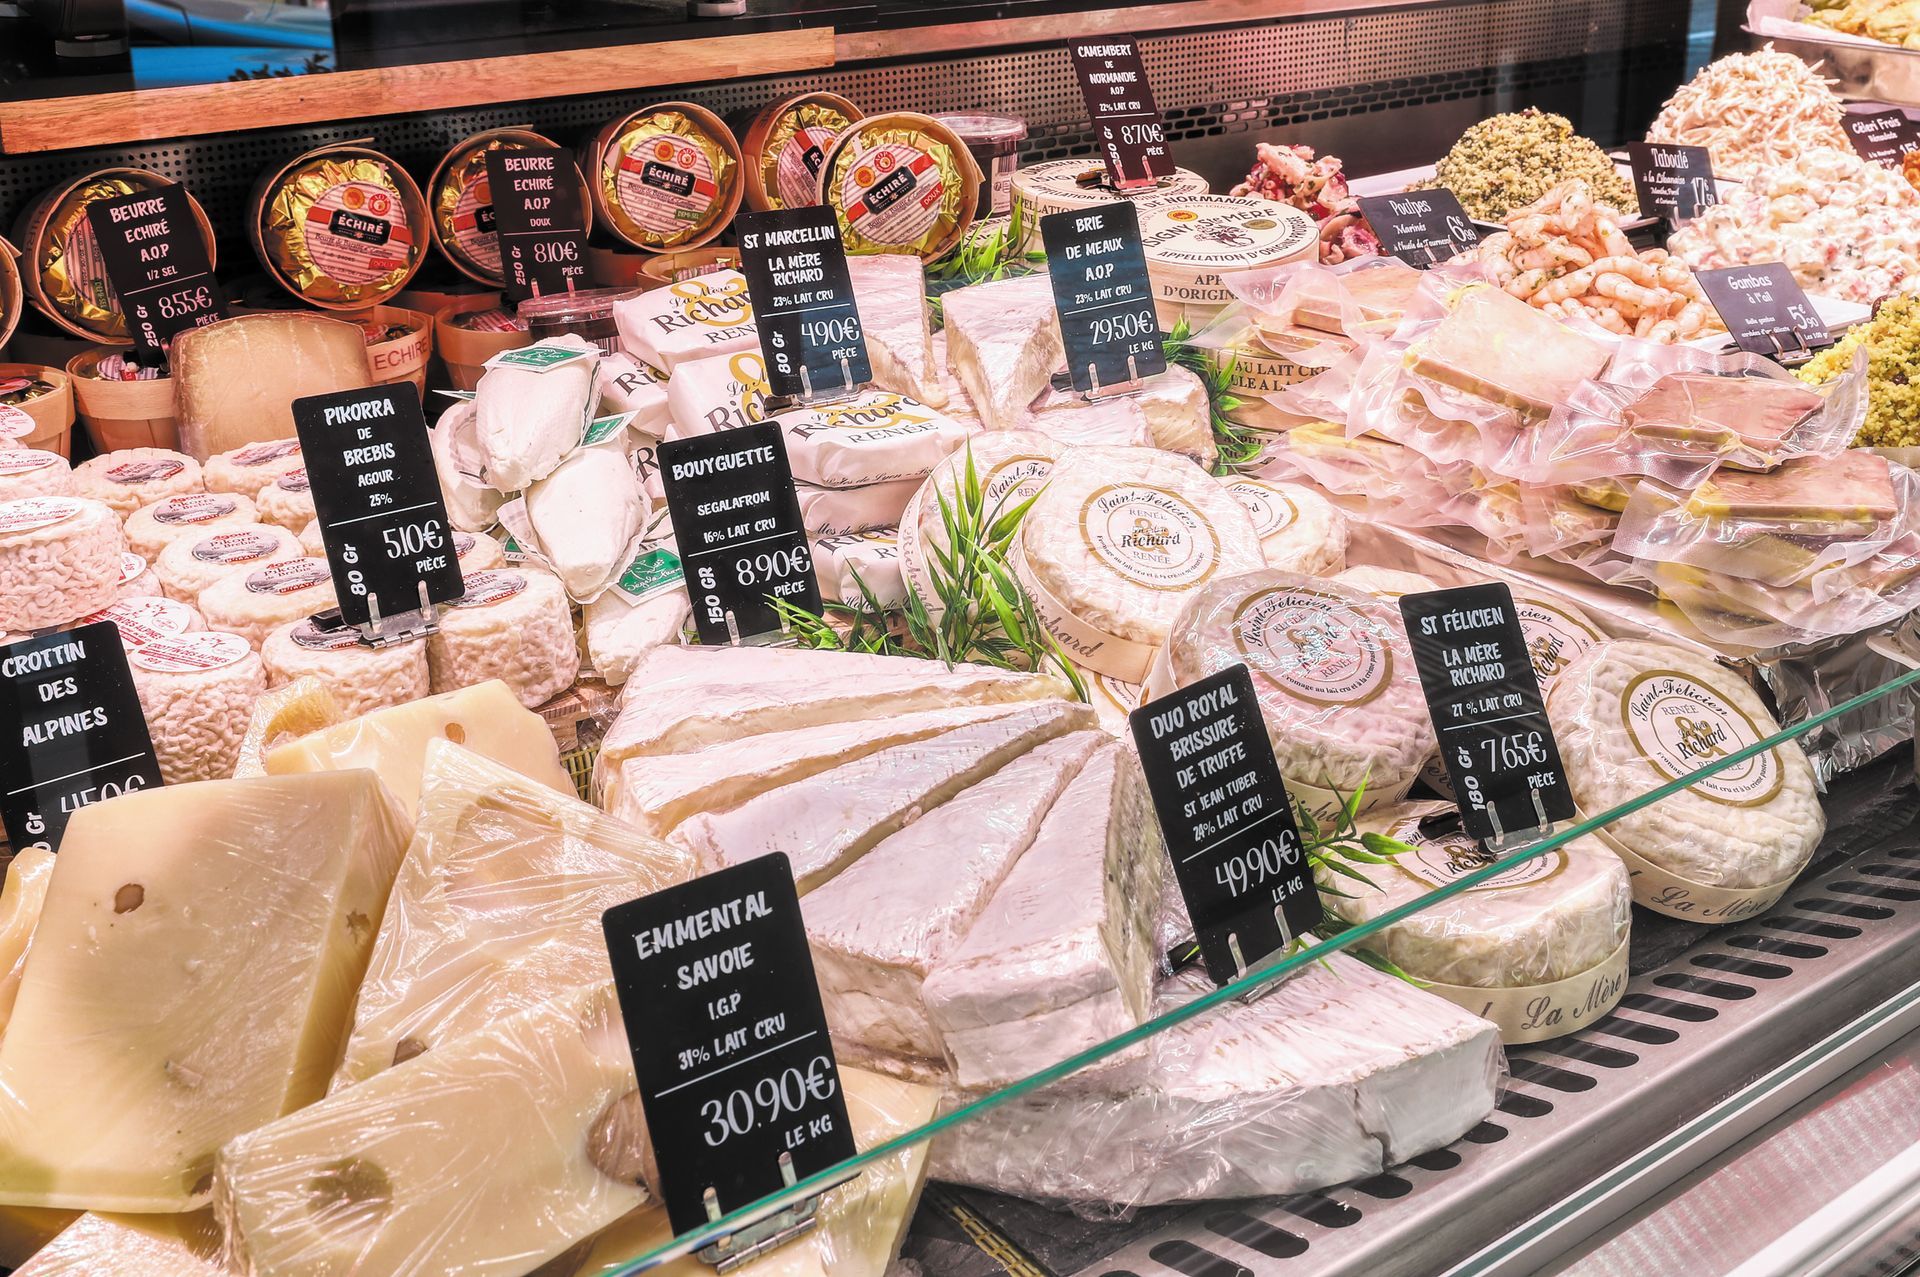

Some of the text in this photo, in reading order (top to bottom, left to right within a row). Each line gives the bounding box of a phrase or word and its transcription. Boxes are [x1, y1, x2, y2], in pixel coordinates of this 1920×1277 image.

[1078, 44, 1132, 57] CAMEMBERT
[1089, 72, 1137, 84] NORMANDIE
[1099, 101, 1140, 112] 22% LAIT CRU
[1852, 117, 1901, 134] Céleri Frais
[1146, 146, 1164, 156] PIÈCE
[1651, 148, 1689, 168] Taboulé
[505, 157, 554, 172] BEURRE
[514, 176, 554, 191] ECHIRÉ
[649, 166, 689, 186] ÉCHIRÉ
[869, 172, 908, 204] ÉCHIRÉ
[923, 189, 941, 205] DOUX
[110, 197, 167, 223] BEURRE
[524, 198, 550, 210] A.O.P
[1148, 195, 1261, 209] DE NORMANDIE
[1389, 199, 1432, 218] Poulpes
[124, 218, 170, 243] ECHIRÉ
[338, 214, 383, 234] ÉCHIRÉ
[530, 218, 551, 227] DOUX
[1075, 215, 1104, 233] BRIE
[744, 226, 836, 249] ST MARCELLIN
[1142, 224, 1194, 248] ISIGNY
[140, 243, 170, 262] A.O.P
[1066, 238, 1124, 260] DE MEAUX
[1158, 237, 1296, 262] APPELLATION D'ORIGINE
[147, 265, 178, 280] 1/2 SEL
[512, 246, 527, 286] 250 Gr
[562, 266, 584, 276] PIÈCE
[768, 252, 822, 272] LA MÈRE
[1086, 263, 1114, 282] A.O.P
[773, 267, 824, 286] RICHARD
[1727, 274, 1772, 290] Gambas
[773, 289, 834, 307] 23% LAIT CRU
[1075, 284, 1132, 304] 23% LAIT CRU
[137, 305, 159, 347] 250 Gr
[195, 313, 220, 326] PIÈCE
[374, 336, 428, 370] ECHIRE
[772, 331, 791, 374] 80 Gr
[832, 347, 857, 360] PIÈCE
[1129, 340, 1154, 355] LE KG
[1257, 363, 1294, 376] LAIT
[324, 399, 395, 426] PIKORRA
[357, 427, 373, 440] DE
[847, 422, 939, 444] RENÉE
[343, 443, 396, 467] BREBIS
[672, 445, 775, 481] BOUYGUETTE
[358, 470, 394, 488] AGOUR
[369, 493, 393, 507] 25%
[697, 491, 770, 516] SEGALAFROM
[1098, 491, 1197, 529] Saint-Félicien
[210, 534, 260, 547] Pikorra
[212, 532, 252, 542] Agour
[704, 518, 776, 544] 16% LAIT CRU
[1121, 532, 1181, 548] Richard
[223, 539, 255, 549] Brebis
[266, 558, 307, 570] Agour
[415, 555, 447, 574] PIÈCE
[735, 545, 811, 587] 8.90€
[1132, 551, 1171, 564] RENÉE
[263, 561, 316, 577] Pikorra
[278, 566, 311, 579] Brebis
[343, 544, 367, 596] 80 Gr
[698, 567, 725, 624] 150 GR
[774, 580, 806, 597] PIÈCE
[1421, 616, 1438, 636] ST
[1442, 606, 1505, 633] FÉLICIEN
[2, 640, 86, 678] CROTTIN
[1442, 642, 1502, 668] LA MÈRE
[1450, 662, 1506, 687] RICHARD
[38, 677, 78, 702] DES
[1631, 679, 1728, 721] Saint-Félicien
[1150, 683, 1238, 739] DUO ROYAL
[1451, 692, 1523, 717] 27 LAIT CRU
[1661, 705, 1700, 715] RENÉE
[23, 706, 108, 747] ALPINES
[1170, 714, 1238, 762] BRISSURE
[1675, 722, 1728, 760] Richard
[1176, 742, 1247, 790] DE TRUFFE
[1458, 747, 1487, 812] 180 Gr
[1527, 771, 1557, 790] PIÈCE
[1706, 781, 1718, 790] lait
[1750, 776, 1763, 789] crème
[1184, 770, 1258, 819] ST JEAN TUBER
[26, 812, 46, 834] Gr
[1193, 794, 1263, 842] 24% LAIT CRU
[1215, 829, 1300, 898] 49.90€
[1272, 876, 1304, 904] LE KG
[1651, 886, 1696, 913] La
[634, 891, 773, 960] EMMENTAL
[677, 943, 754, 990] SAVOIE
[708, 993, 742, 1021] I.G.P
[1520, 974, 1622, 1030] La Mère
[678, 1013, 786, 1071] 31% LAIT CRU
[701, 1055, 836, 1147] 30.90€
[785, 1114, 833, 1149] LE KG
